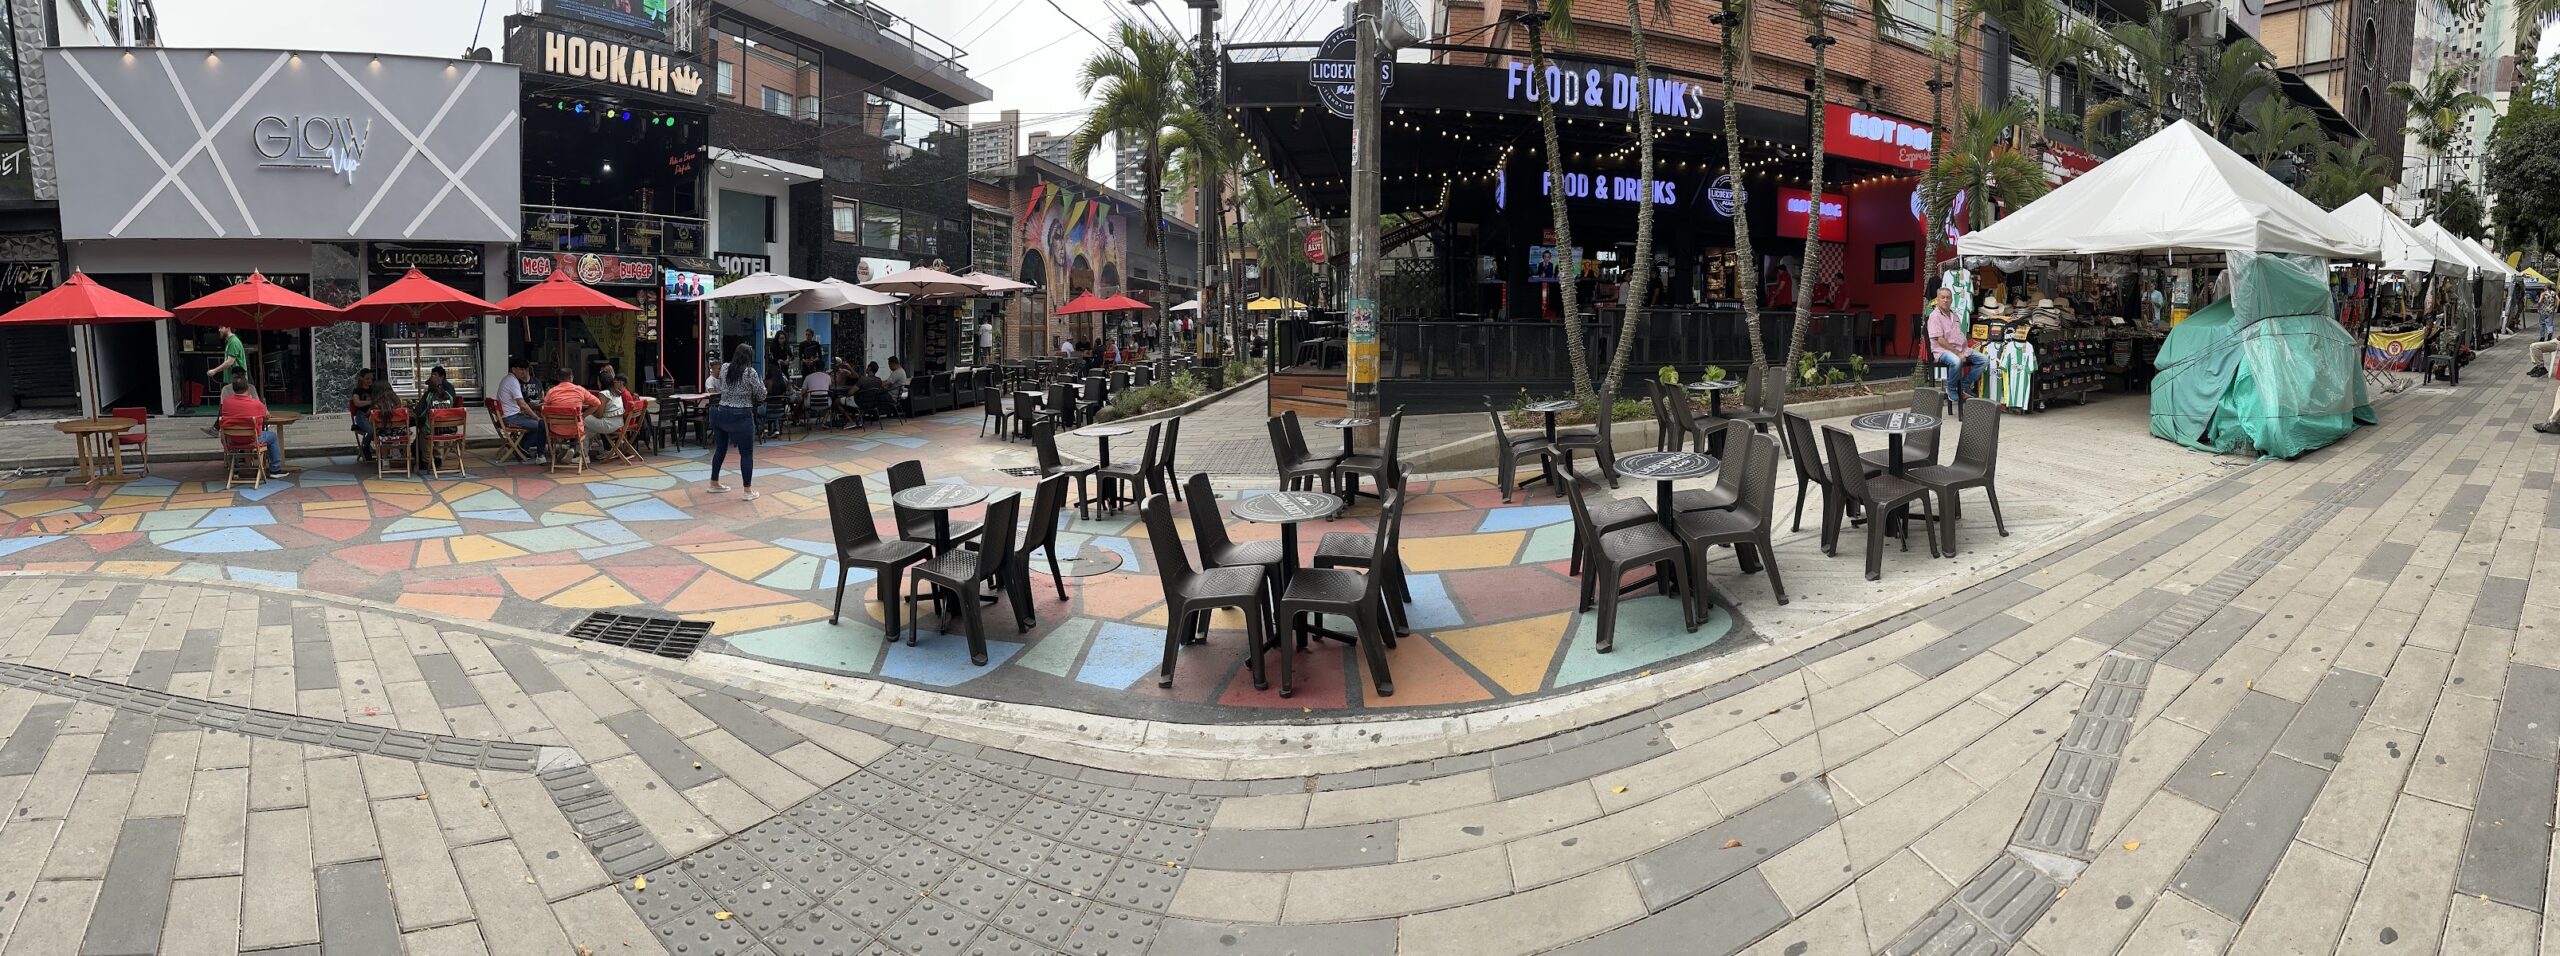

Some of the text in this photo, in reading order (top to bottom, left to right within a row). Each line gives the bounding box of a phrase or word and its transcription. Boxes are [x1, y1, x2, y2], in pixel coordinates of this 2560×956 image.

[545, 31, 669, 93] HOOKAH
[1312, 62, 1391, 80] LICOEXS
[1508, 61, 1579, 106] FOOD
[1584, 69, 1604, 108] &
[253, 115, 371, 160] GLOW
[1849, 111, 1898, 144] HOT
[0, 147, 27, 176] ËT
[1594, 174, 1609, 200] &
[395, 253, 479, 266] LICORERA.COM
